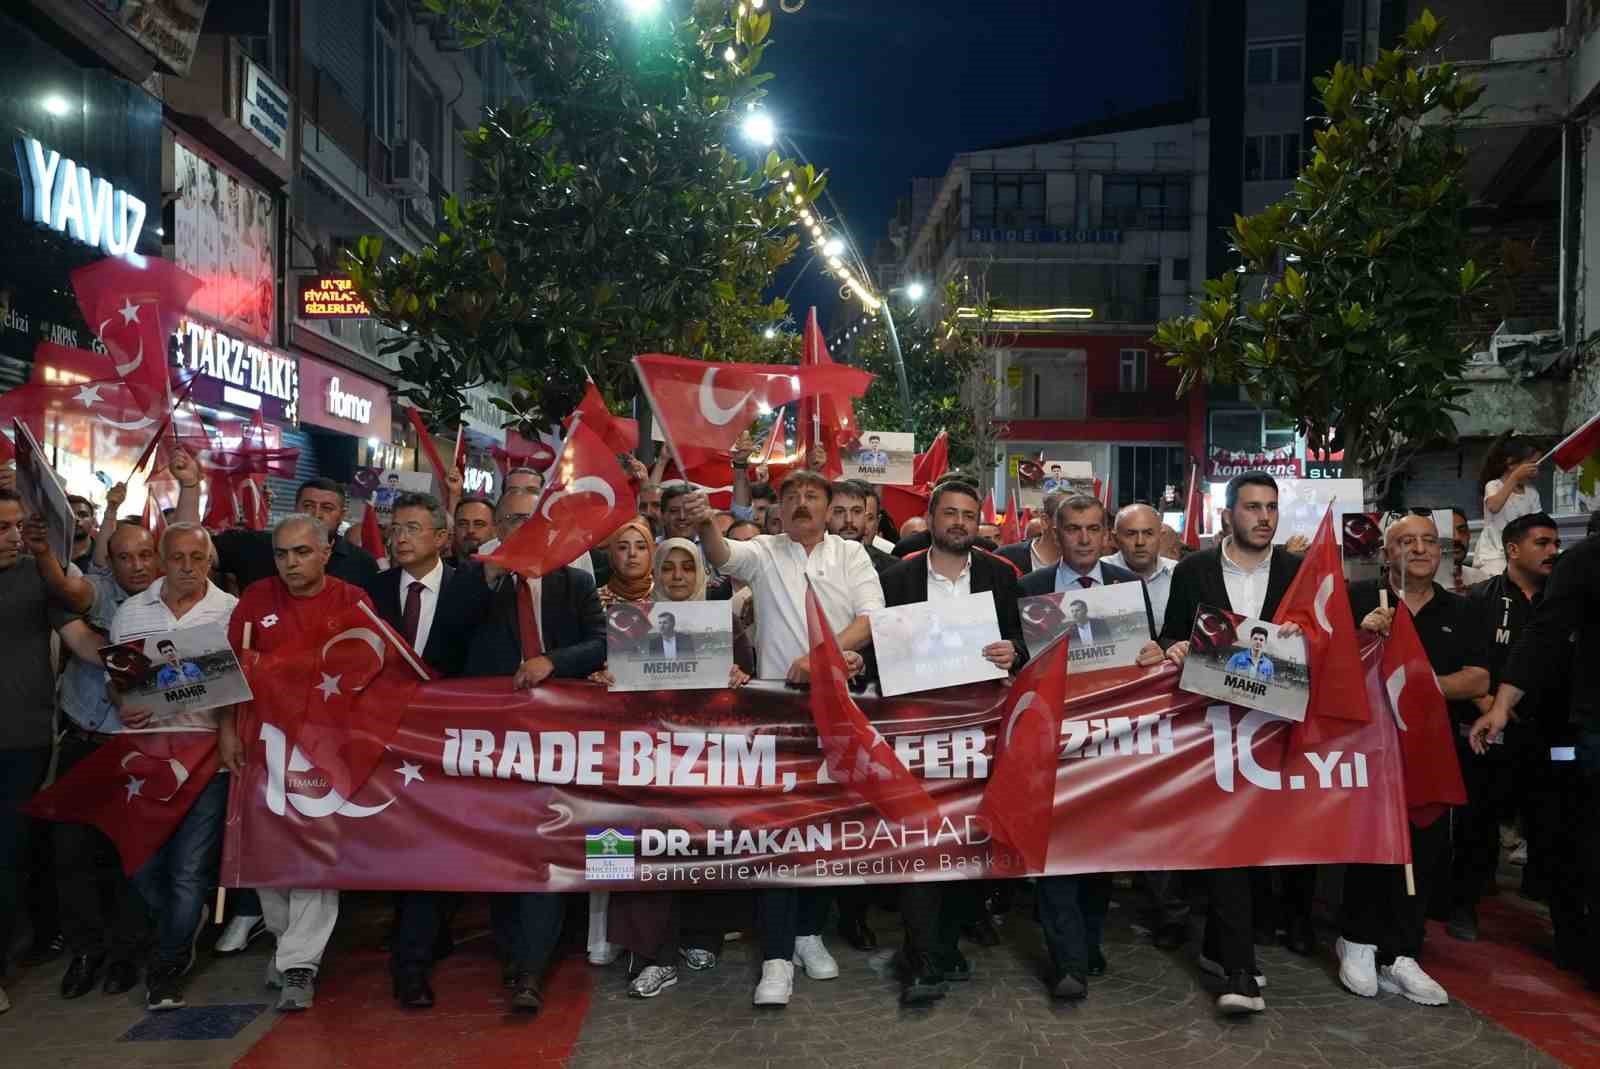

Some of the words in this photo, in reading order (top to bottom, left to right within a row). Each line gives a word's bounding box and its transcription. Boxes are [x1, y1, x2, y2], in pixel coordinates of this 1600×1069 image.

[17, 135, 147, 270] YAVUZ
[643, 661, 698, 674] MEHMET
[442, 728, 604, 785] İRADE
[618, 730, 798, 793] BİZİM,
[640, 828, 698, 857] DR.
[707, 822, 833, 857] HAKAN
[640, 861, 802, 884] Bahçelievler
[815, 855, 926, 878] Belediye
